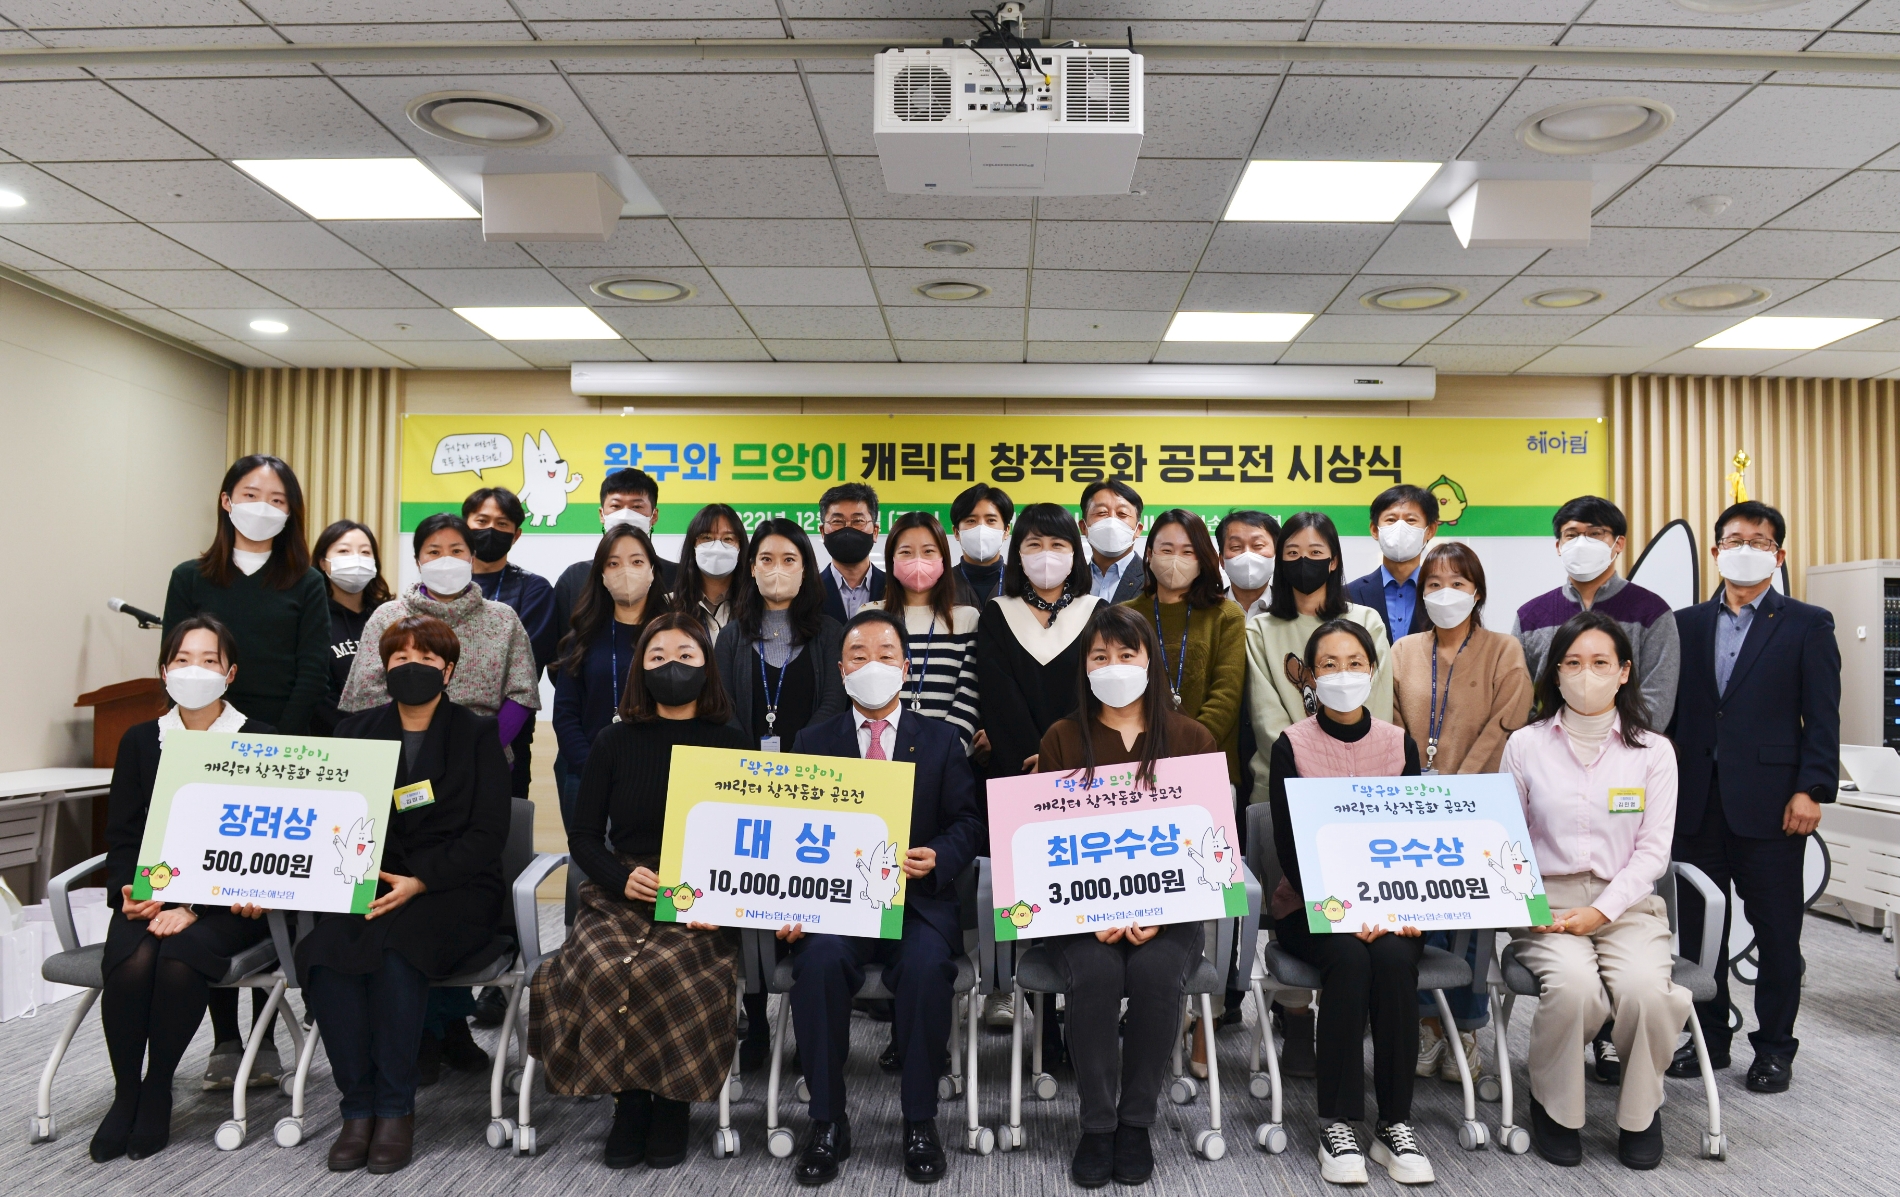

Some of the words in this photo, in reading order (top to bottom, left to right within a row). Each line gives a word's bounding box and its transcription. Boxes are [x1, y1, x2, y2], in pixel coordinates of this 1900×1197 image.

[445, 442, 470, 453] 수상자
[474, 437, 498, 450] 여러분
[1526, 430, 1588, 454] 헤아림
[604, 442, 721, 482] 왕구와
[732, 442, 846, 482] 므앙이
[860, 442, 975, 482] 캐릭터
[990, 442, 1148, 483] 창작동화
[1158, 444, 1274, 483] 공모전
[1287, 444, 1402, 484] 시상식
[204, 761, 250, 777] 캐릭터
[255, 762, 311, 780] 창작동화
[316, 766, 349, 782] 공모전
[714, 779, 762, 796] 캐릭터
[767, 781, 825, 801] 창작동화
[830, 786, 865, 804] 공모전
[1034, 797, 1081, 812] 캐릭터
[1085, 790, 1143, 808] 창작동화
[1149, 785, 1182, 802] 공모전
[218, 803, 317, 840] 장려상
[1334, 801, 1380, 816] 캐릭터
[1384, 800, 1439, 815] 창작동화
[1444, 799, 1476, 814] 공모전
[734, 818, 772, 859] 대
[795, 823, 836, 864] 상
[1047, 823, 1181, 867] 최우수상
[1368, 836, 1465, 869] 우수상
[202, 849, 313, 879] 500,000원
[709, 869, 853, 904] 10,000,000원
[1048, 868, 1186, 905] 3,000,000원
[1357, 877, 1490, 903] 2,000,000원
